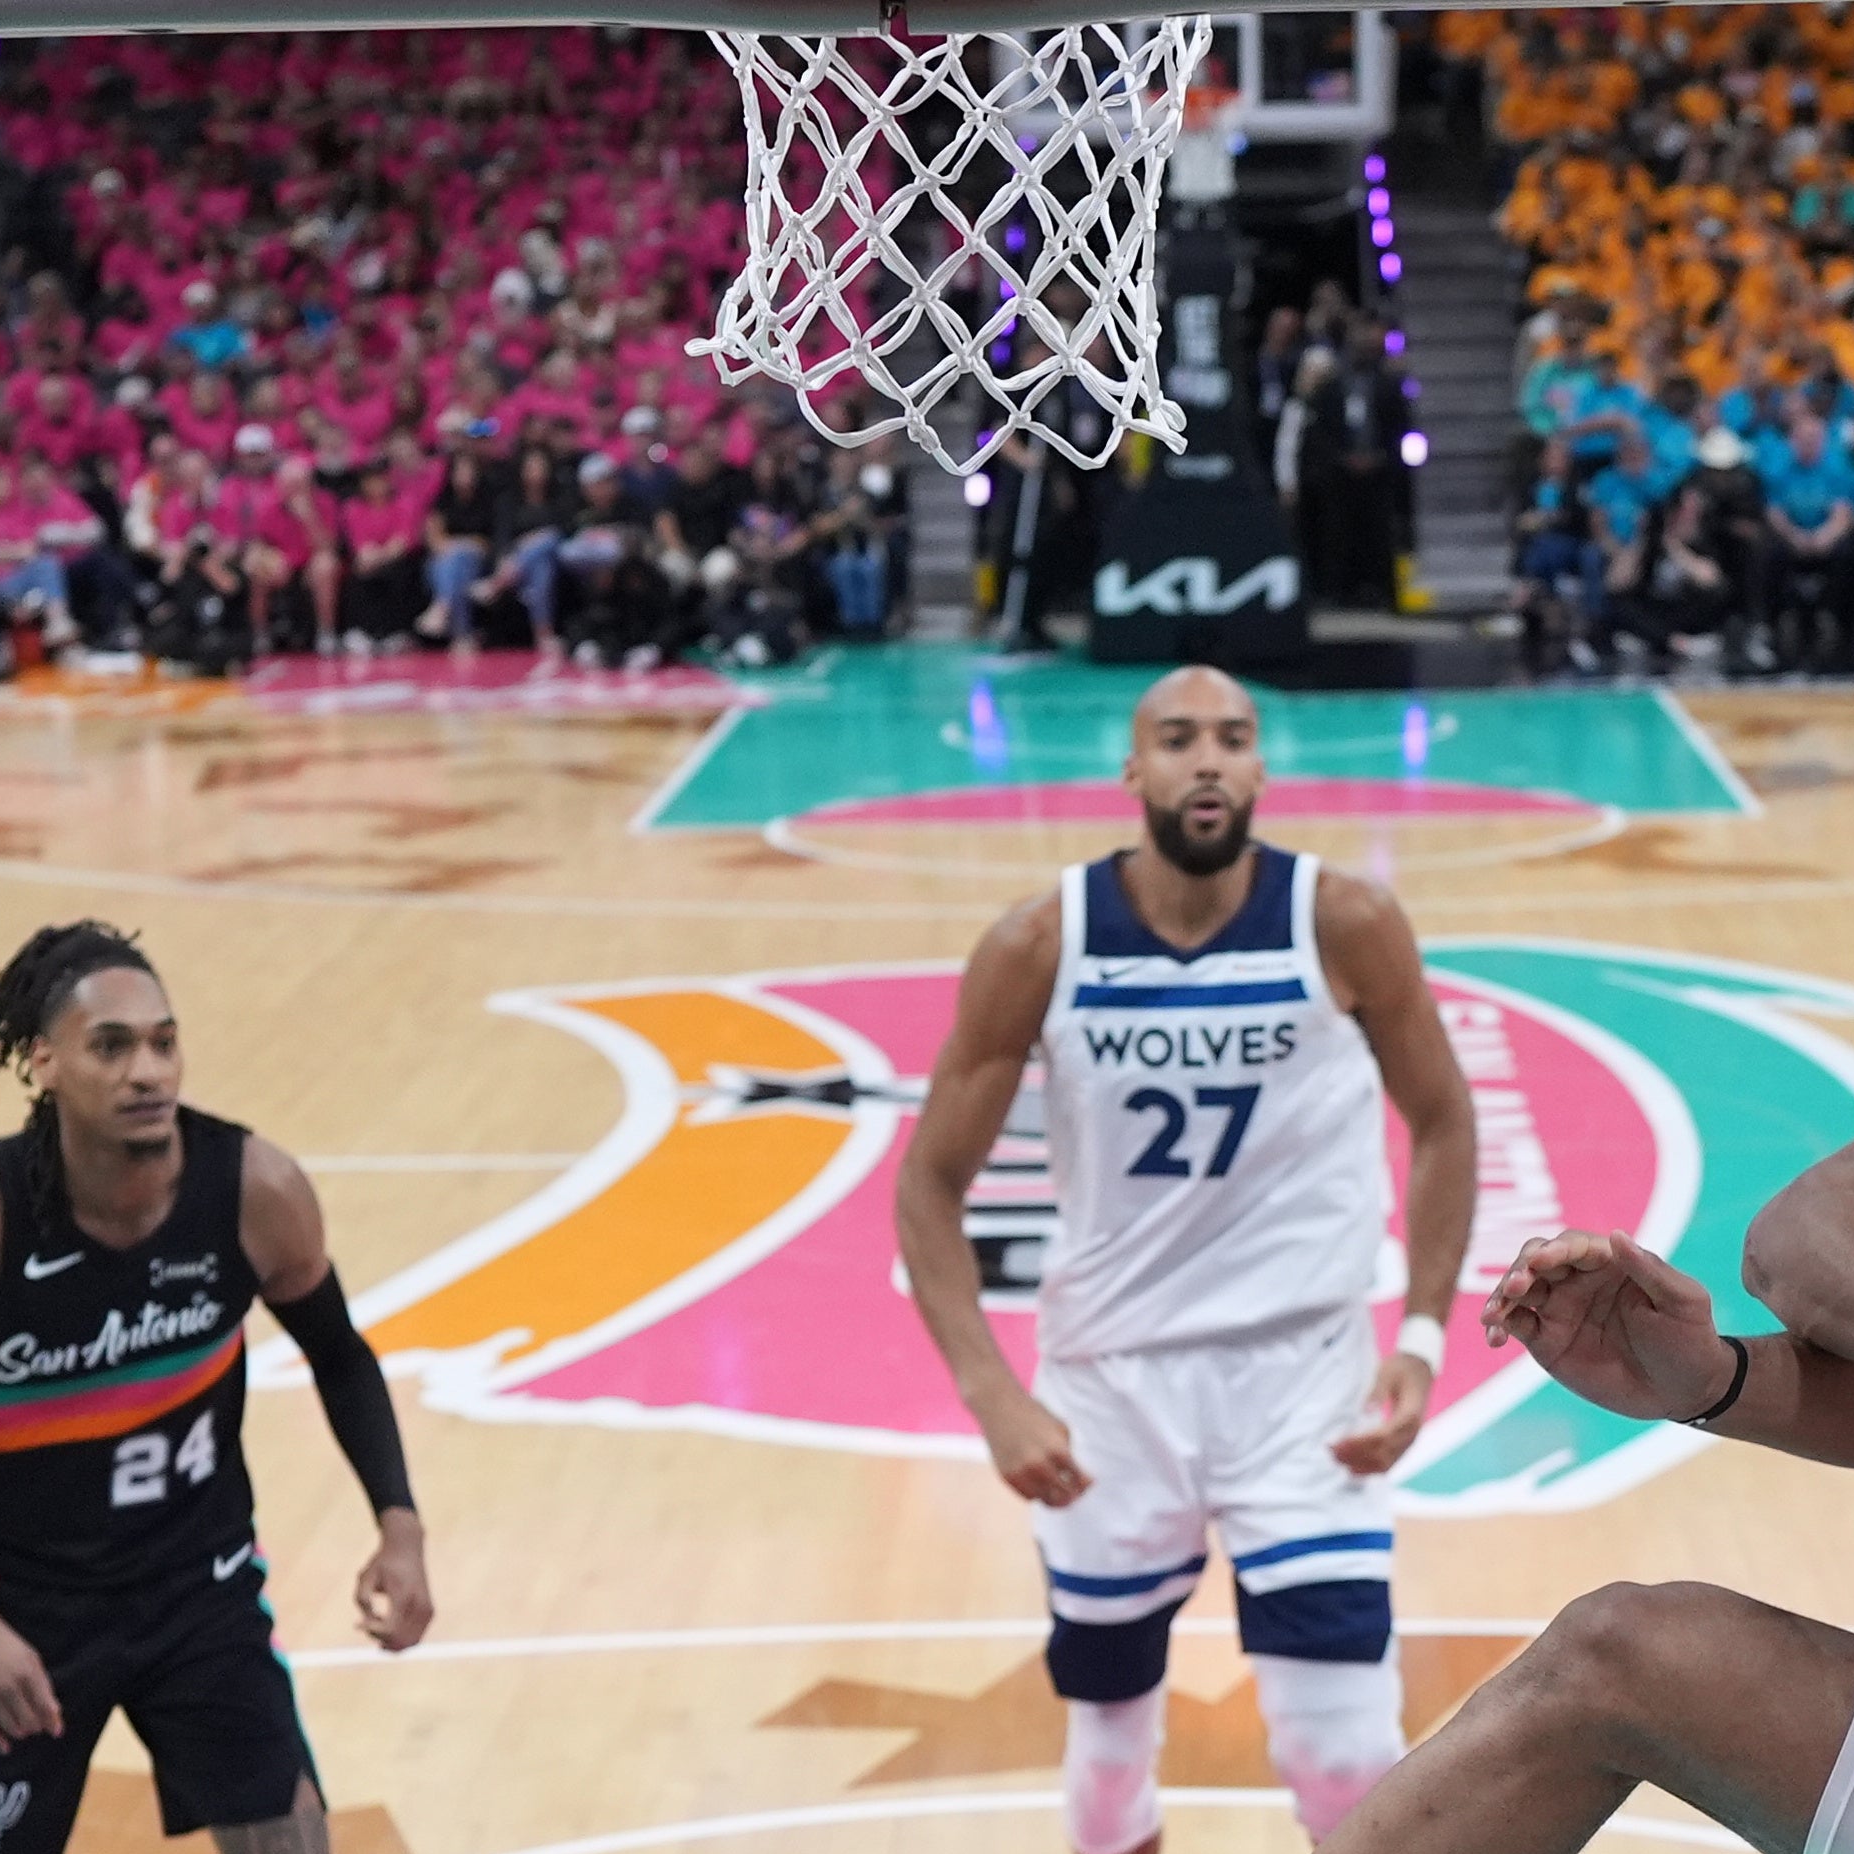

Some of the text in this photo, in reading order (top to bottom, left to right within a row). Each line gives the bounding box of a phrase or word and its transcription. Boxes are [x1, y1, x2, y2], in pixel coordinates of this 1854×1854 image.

[1085, 1022, 1297, 1068] WOLVES
[1125, 1084, 1262, 1178] 27
[80, 1291, 222, 1369] Antonio
[110, 1410, 217, 1508] 24
